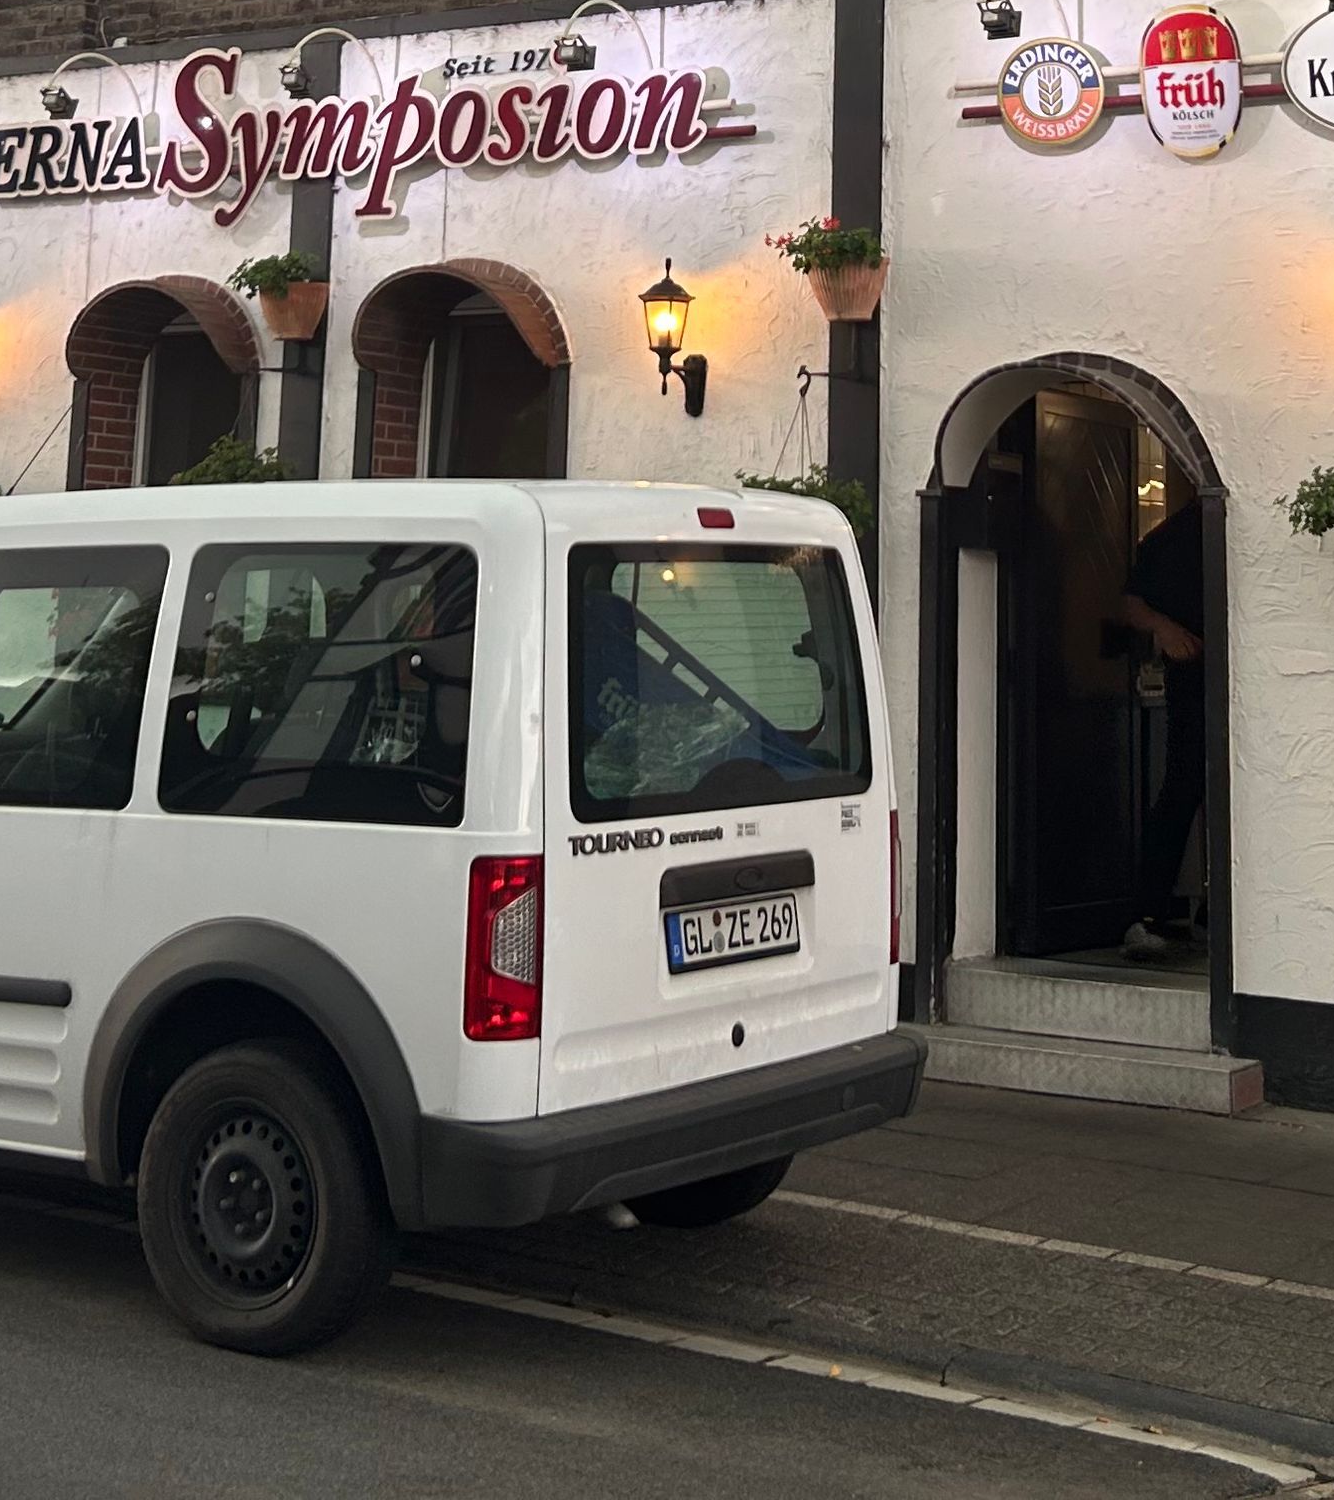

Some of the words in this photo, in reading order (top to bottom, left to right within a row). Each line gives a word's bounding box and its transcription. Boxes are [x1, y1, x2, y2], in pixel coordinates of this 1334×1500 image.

[443, 55, 495, 79] Seit
[509, 48, 552, 72] 197
[1005, 44, 1094, 88] ERDINGER
[1156, 67, 1225, 110] früh
[1172, 109, 1214, 121] KÖLSCH
[157, 50, 704, 227] Symposion
[568, 827, 665, 856] TOURNEO
[683, 916, 713, 956] GL
[726, 909, 754, 949] ZE
[757, 903, 793, 943] 269
